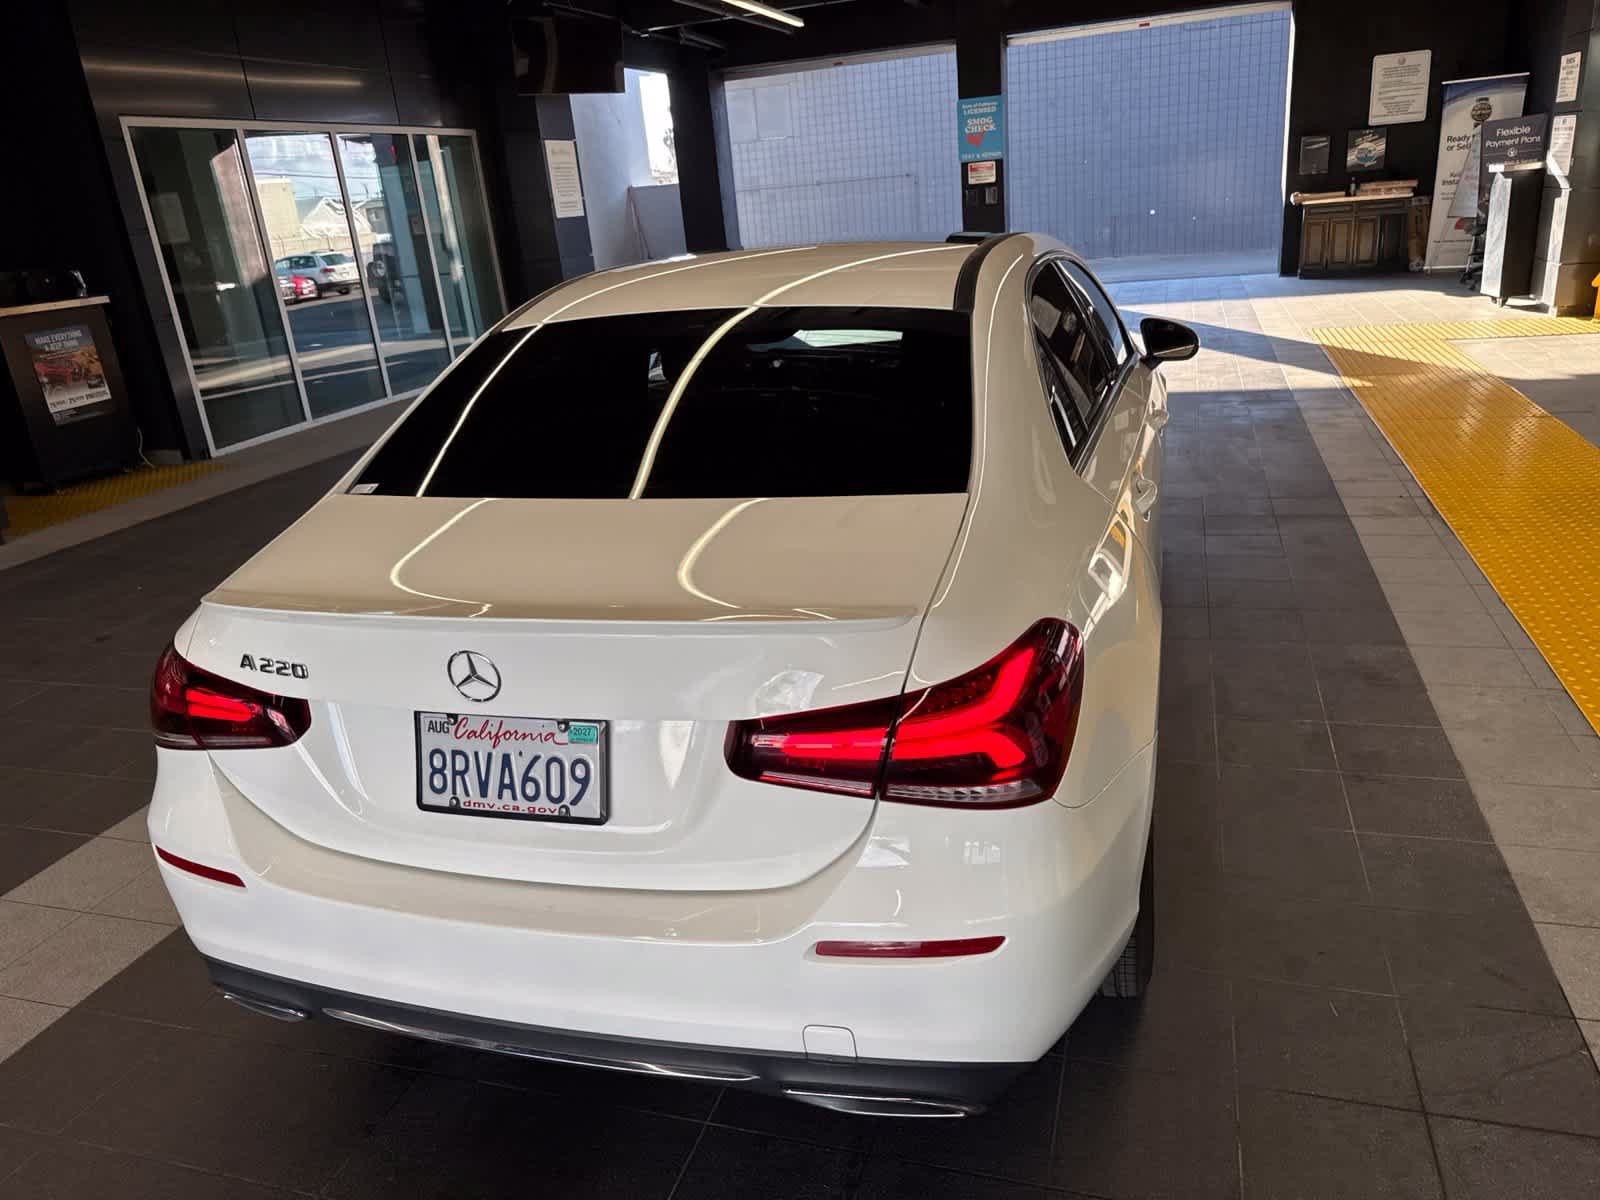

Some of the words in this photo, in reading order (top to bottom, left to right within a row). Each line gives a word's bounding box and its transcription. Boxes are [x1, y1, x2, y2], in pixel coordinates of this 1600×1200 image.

[967, 115, 993, 126] SMOG
[964, 122, 997, 134] CHECK
[1496, 126, 1531, 137] Flexible
[1446, 134, 1471, 145] Ready
[1485, 137, 1519, 148] Payment
[240, 653, 258, 671] A
[259, 657, 309, 679] 220
[427, 719, 450, 734] AUG
[453, 716, 569, 749] California
[573, 727, 592, 737] 2027
[428, 747, 592, 806] 8RVA609
[462, 800, 558, 815] dmv.ca.gov
